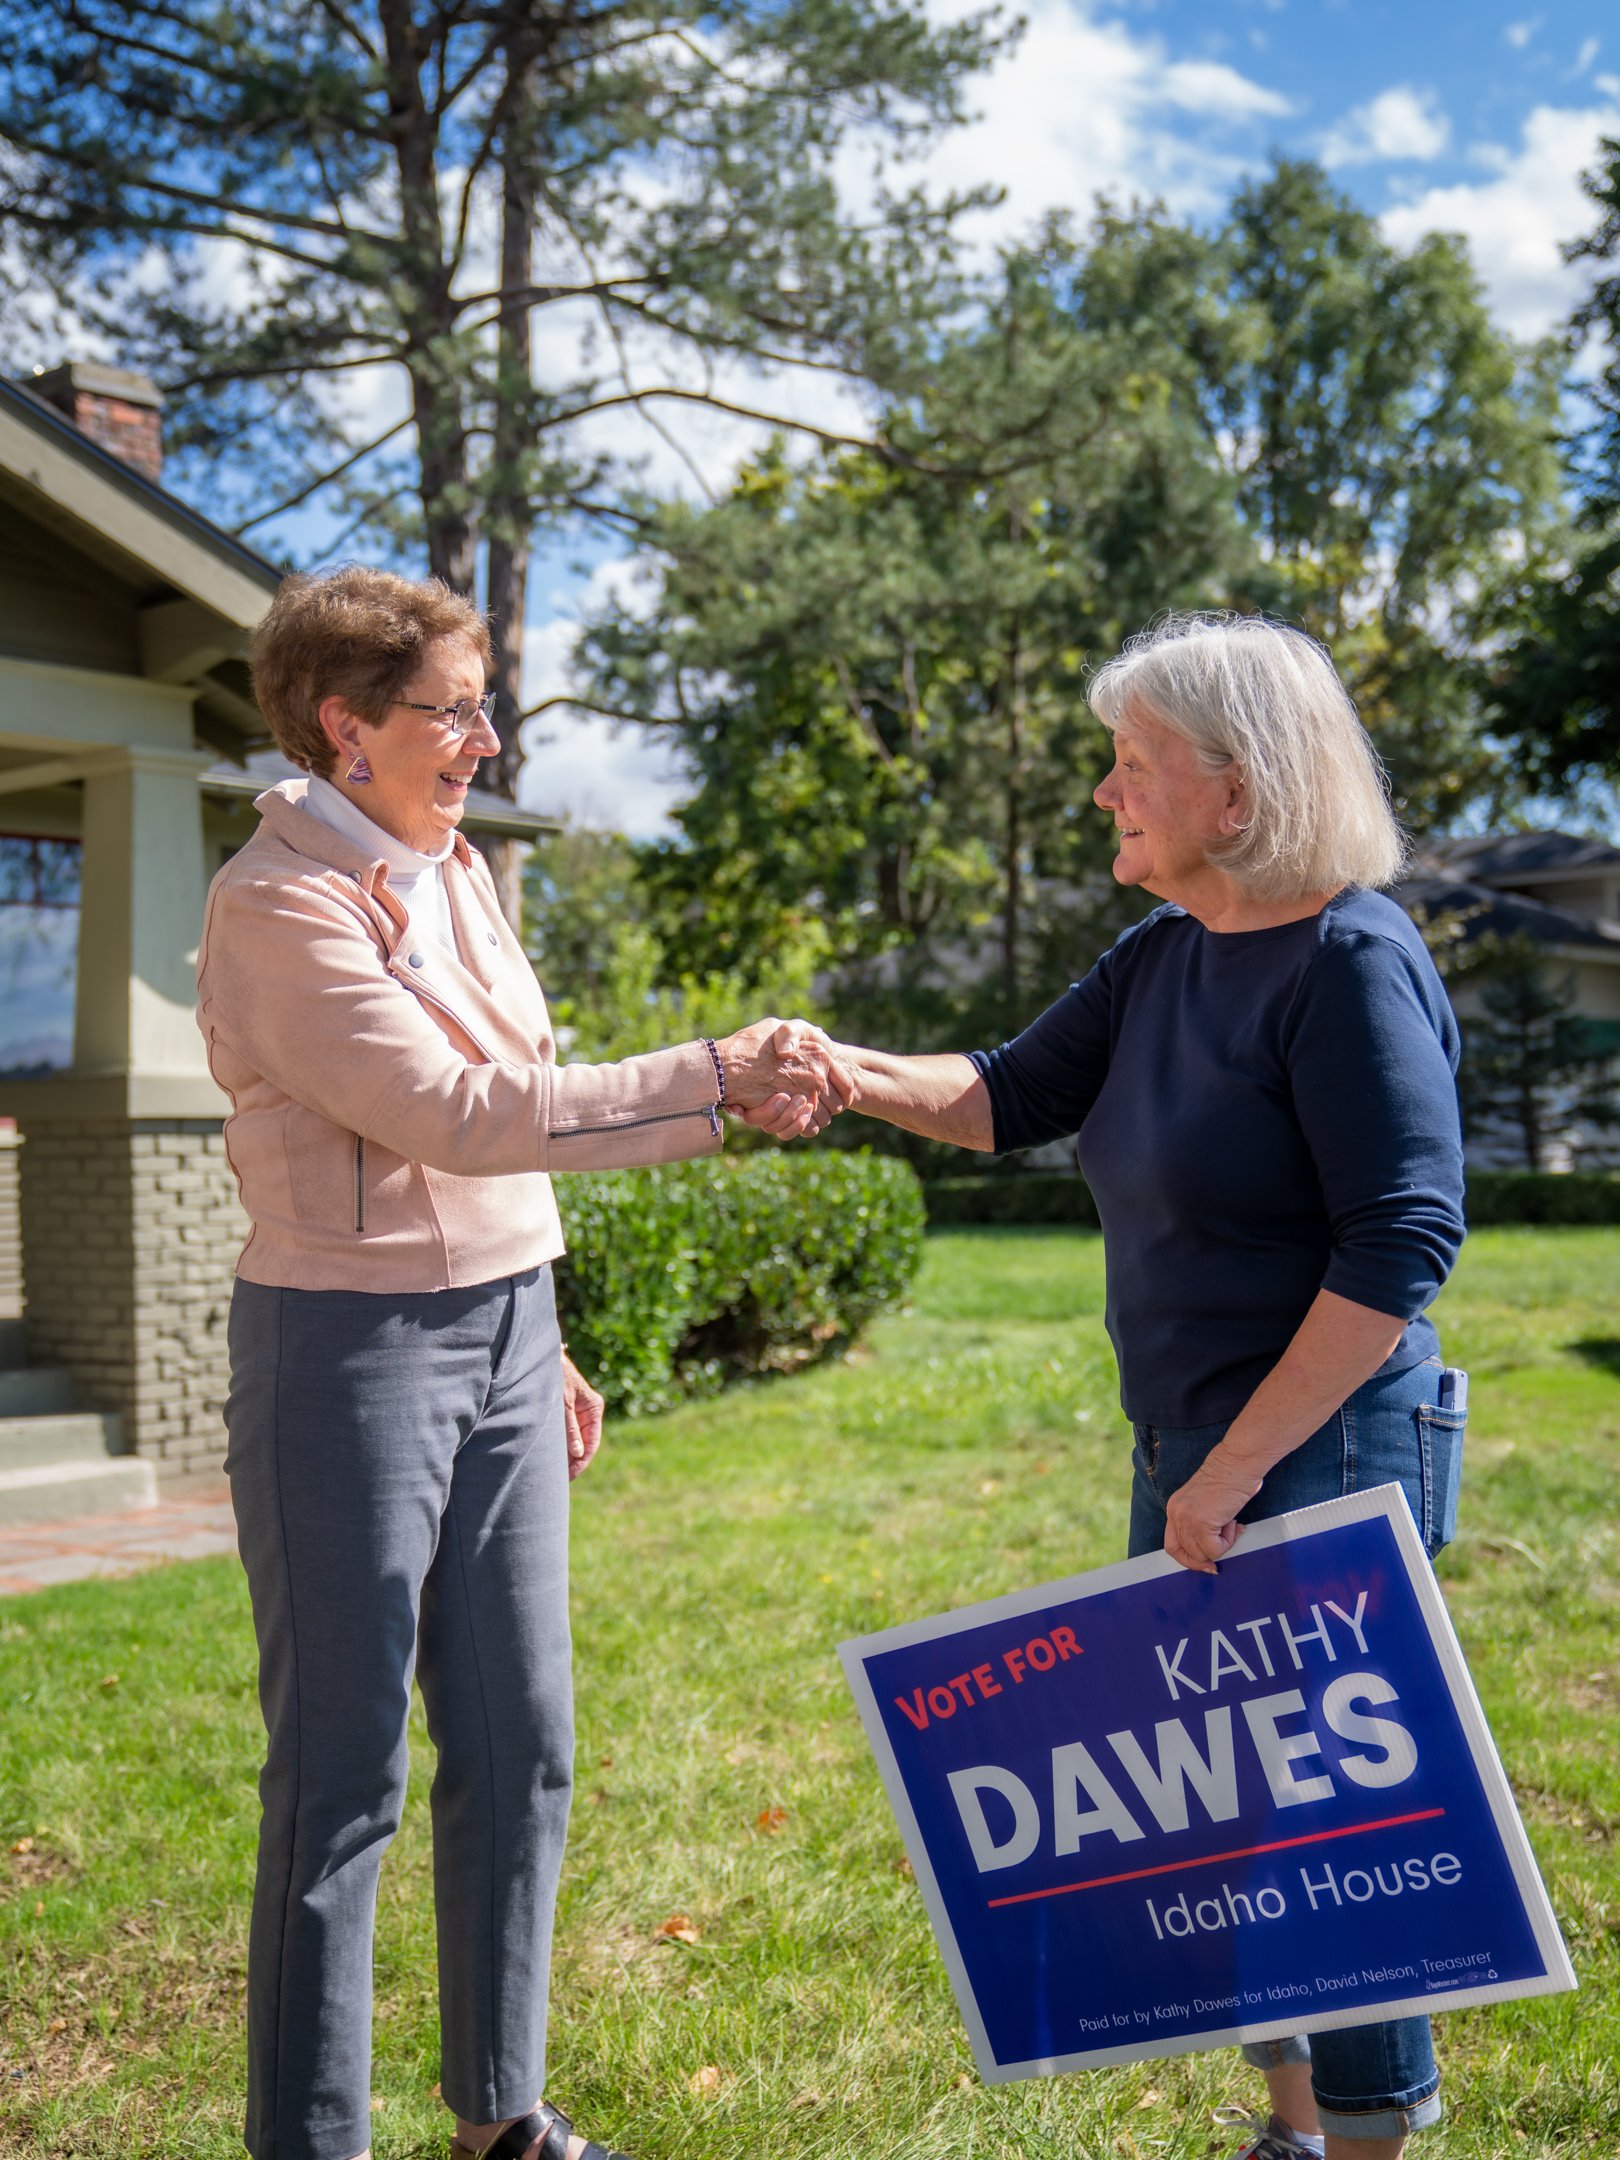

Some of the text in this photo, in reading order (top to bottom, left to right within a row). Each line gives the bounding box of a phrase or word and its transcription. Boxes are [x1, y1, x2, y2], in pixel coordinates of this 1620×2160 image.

[894, 1626, 1085, 1731] VOTE FOR
[1155, 1591, 1371, 1700] KATHY
[946, 1672, 1419, 1874] DAWES
[1146, 1852, 1463, 1940] Idaho House
[1079, 1950, 1492, 2032] Paid for by Kathy Dawes for Idaho, David Nelson, Treasurer
